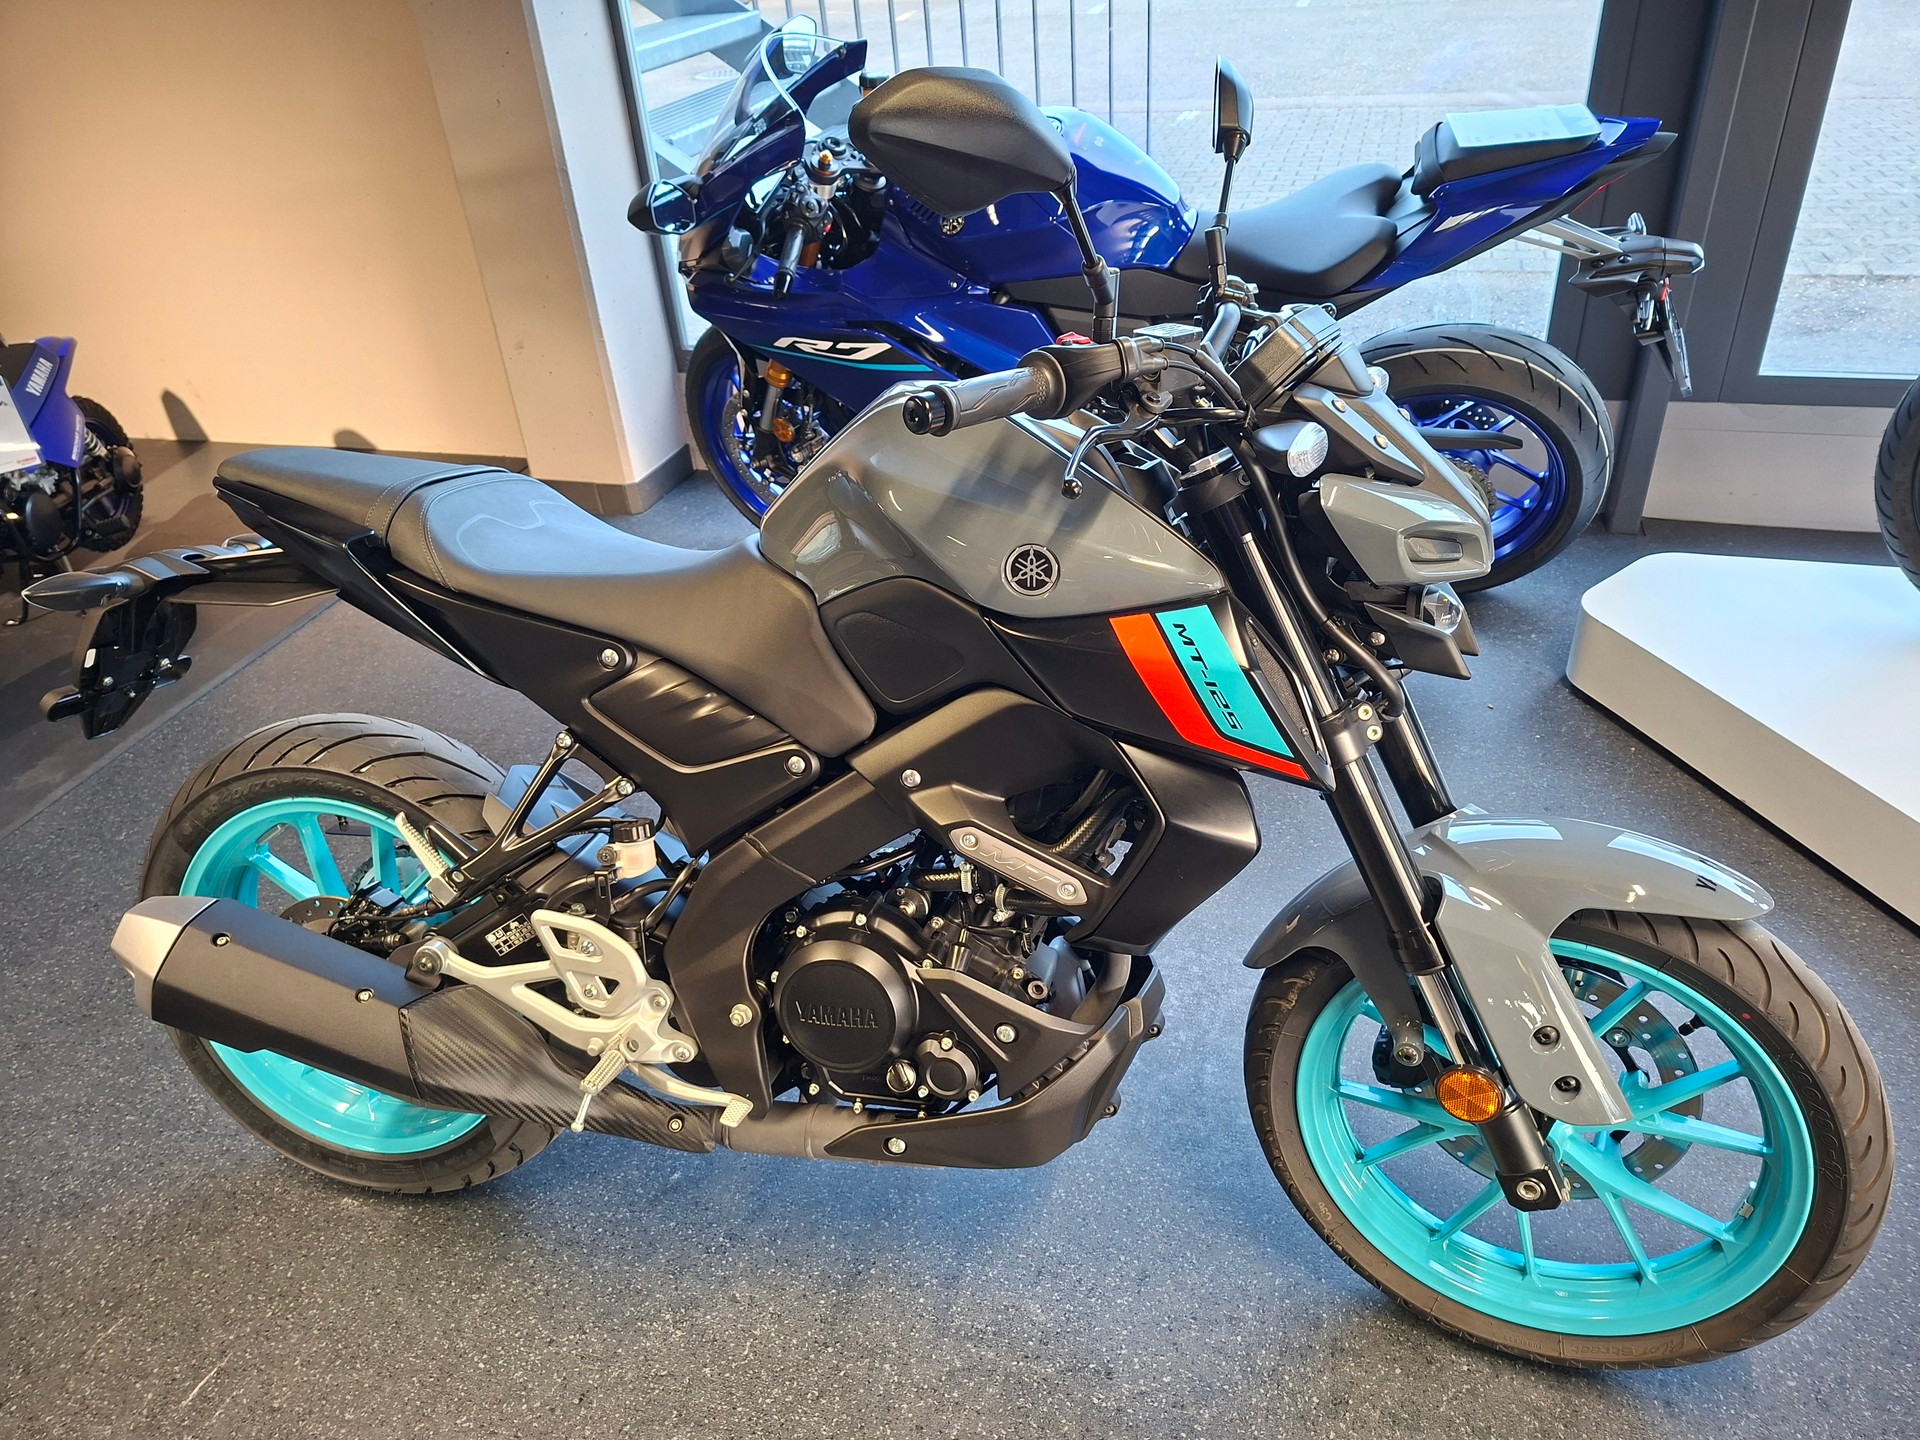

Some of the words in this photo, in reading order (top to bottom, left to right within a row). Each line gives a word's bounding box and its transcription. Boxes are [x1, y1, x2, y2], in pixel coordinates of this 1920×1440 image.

[773, 337, 892, 360] R7
[26, 358, 53, 396] YAMAHA
[1172, 623, 1243, 731] MT-125
[795, 1001, 878, 1029] YAMAHA
